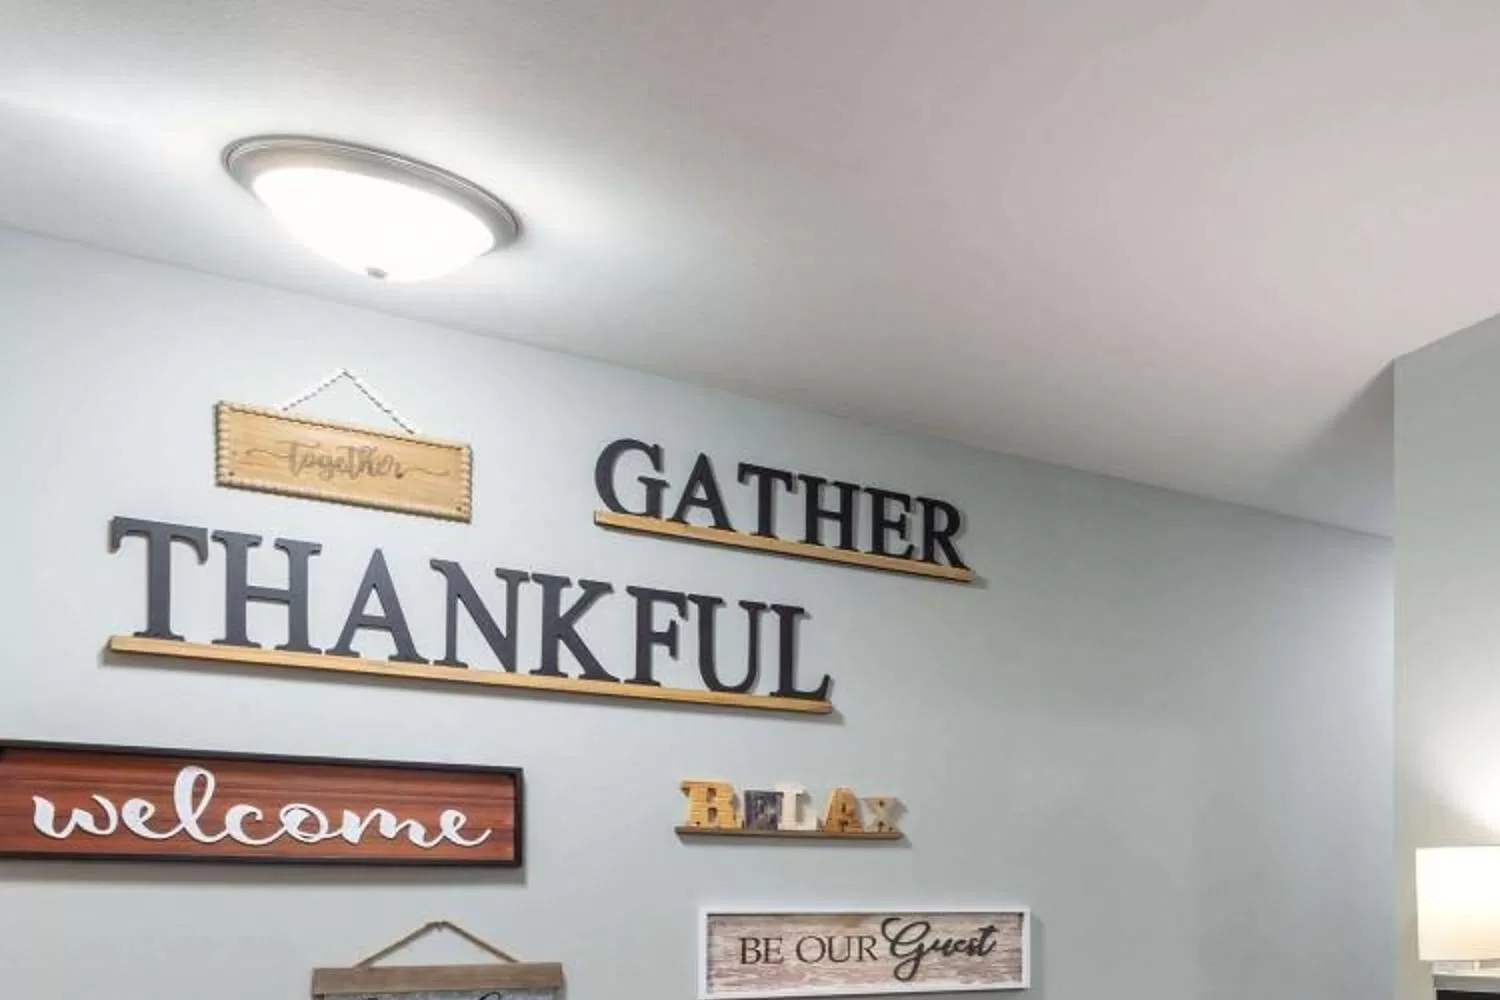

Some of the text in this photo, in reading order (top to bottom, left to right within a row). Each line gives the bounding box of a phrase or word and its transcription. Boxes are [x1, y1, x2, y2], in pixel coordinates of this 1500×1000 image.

[594, 437, 972, 571] GATHER
[110, 515, 833, 700] THANKFUL
[32, 765, 493, 848] welcome
[739, 917, 998, 982] BE OUR Guest
